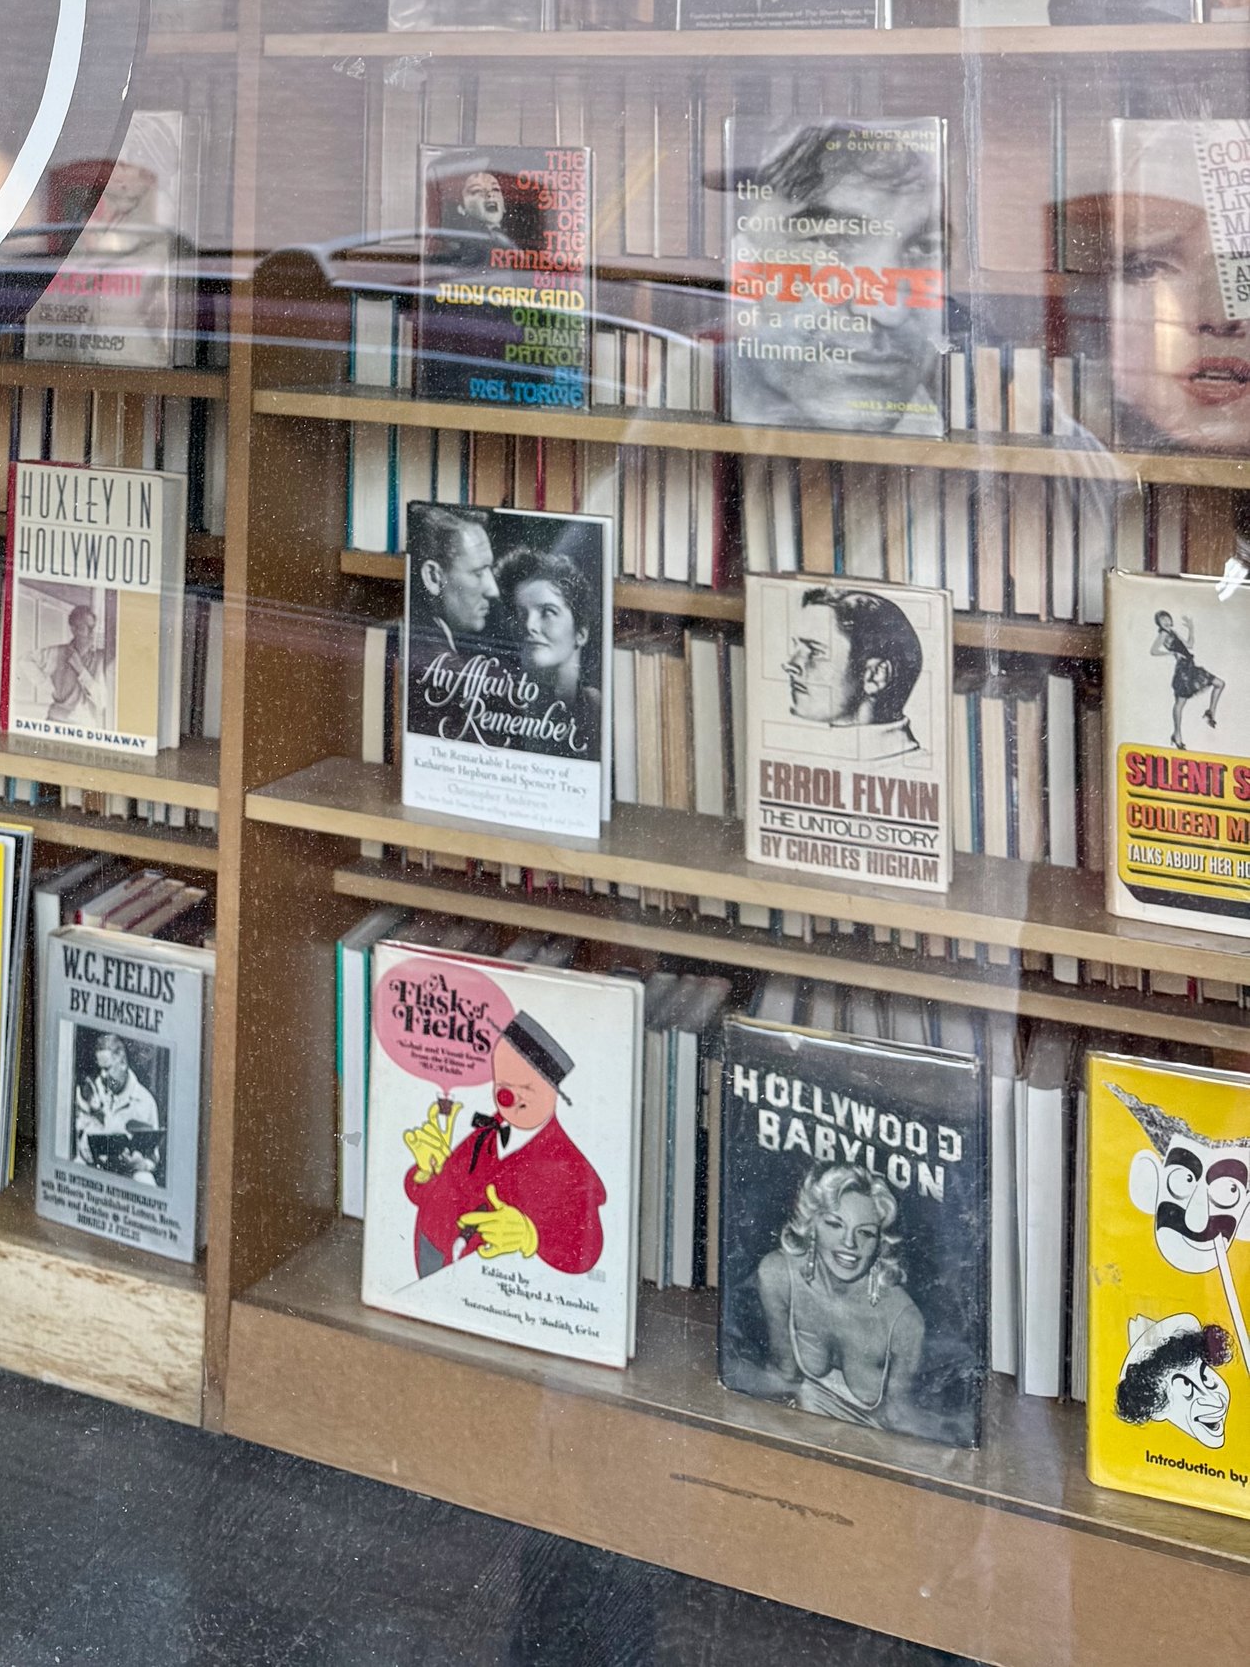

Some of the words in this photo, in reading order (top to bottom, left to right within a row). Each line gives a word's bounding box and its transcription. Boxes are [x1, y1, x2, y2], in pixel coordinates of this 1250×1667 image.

[825, 141, 841, 150] OF
[847, 141, 890, 151] OLIVER
[894, 142, 937, 152] STONE
[862, 129, 937, 140] BIOGRAPHY
[545, 151, 585, 171] THE
[516, 170, 585, 190] OTHER
[737, 179, 773, 199] the
[538, 191, 585, 211] SIDE
[558, 211, 585, 232] OF
[737, 215, 902, 239] controversies,
[543, 231, 585, 252] THE
[490, 248, 585, 272] RAINBOW
[737, 247, 845, 268] excesses,
[436, 283, 485, 306] JUDY
[487, 287, 586, 310] GARLAND
[731, 262, 943, 309] STONE
[736, 273, 779, 296] and
[790, 276, 885, 300] exploits
[512, 308, 539, 327] ON
[543, 310, 585, 330] THE
[737, 305, 760, 327] of
[769, 313, 782, 328] a
[794, 310, 873, 332] radical
[524, 327, 585, 347] DAWN
[737, 337, 856, 364] filmmaker
[505, 345, 585, 367] PATROL
[469, 378, 508, 399] MEL
[554, 366, 584, 385] BY
[20, 470, 115, 525] HUXLEY
[126, 480, 152, 530] IN
[19, 526, 151, 586] HOLLYWOOD
[416, 652, 454, 692] An
[428, 654, 527, 708] Affair
[517, 672, 540, 702] to
[15, 718, 51, 734] DAVID
[54, 724, 83, 739] KING
[87, 729, 148, 749] DUNAWAY
[439, 695, 588, 753] Remember
[430, 746, 448, 759] The
[450, 749, 503, 768] Remarkable
[505, 758, 528, 772] Love
[531, 762, 558, 780] Story
[558, 767, 570, 778] of
[1125, 751, 1228, 799] SILENT
[458, 765, 498, 783] Hepburn
[500, 772, 518, 784] and
[520, 775, 557, 791] Spencer
[560, 781, 588, 799] Tracy
[760, 759, 846, 811] ERROL
[852, 773, 939, 823] FLYNN
[760, 807, 794, 829] THE
[800, 811, 872, 840] UNTOLD
[876, 825, 939, 850] STORY
[1126, 802, 1220, 840] COLLEEN
[760, 833, 782, 858] BY
[786, 837, 860, 872] CHARLES
[866, 850, 939, 884] HIGHAM
[1127, 843, 1163, 866] TALKS
[1165, 850, 1206, 873] ABOUT
[1209, 856, 1233, 877] HER
[423, 974, 449, 993] A
[69, 987, 89, 1017] BY
[95, 995, 164, 1035] HIMSELF
[389, 979, 472, 1018] Flask
[473, 1001, 489, 1020] of
[392, 1003, 492, 1055] Fields
[733, 1063, 963, 1163] HOLLYWOOD
[757, 1108, 945, 1204] BABYLON
[481, 1265, 516, 1283] Edited
[518, 1272, 530, 1287] by
[497, 1281, 542, 1300] Richard
[461, 1297, 523, 1324] Introduction
[525, 1311, 536, 1325] by
[1144, 1449, 1226, 1482] Introduction
[1229, 1459, 1249, 1488] by
